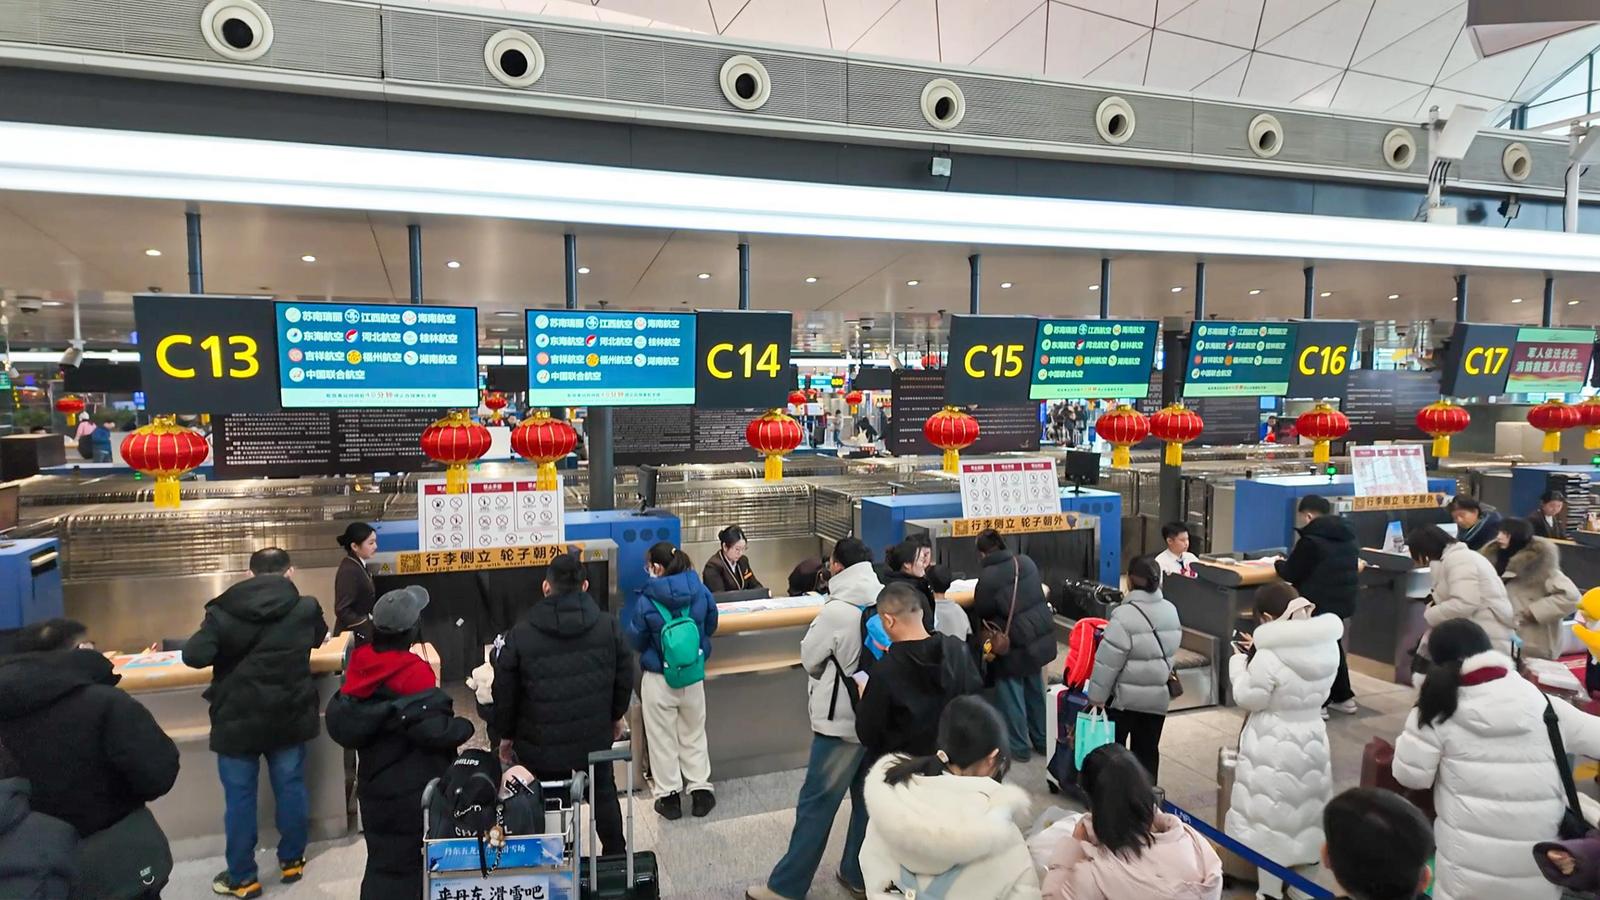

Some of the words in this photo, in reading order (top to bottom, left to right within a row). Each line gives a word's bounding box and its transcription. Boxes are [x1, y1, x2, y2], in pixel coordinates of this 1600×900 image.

[155, 334, 260, 378] C13
[707, 343, 781, 379] C14
[964, 344, 1025, 378] C15
[1299, 345, 1348, 375] C16
[1464, 346, 1509, 375] C17
[972, 519, 1015, 530] 行李侧立
[1022, 515, 1063, 527] 轮子朝外
[426, 551, 490, 566] 行李侧立
[501, 547, 562, 561] 轮子朝外
